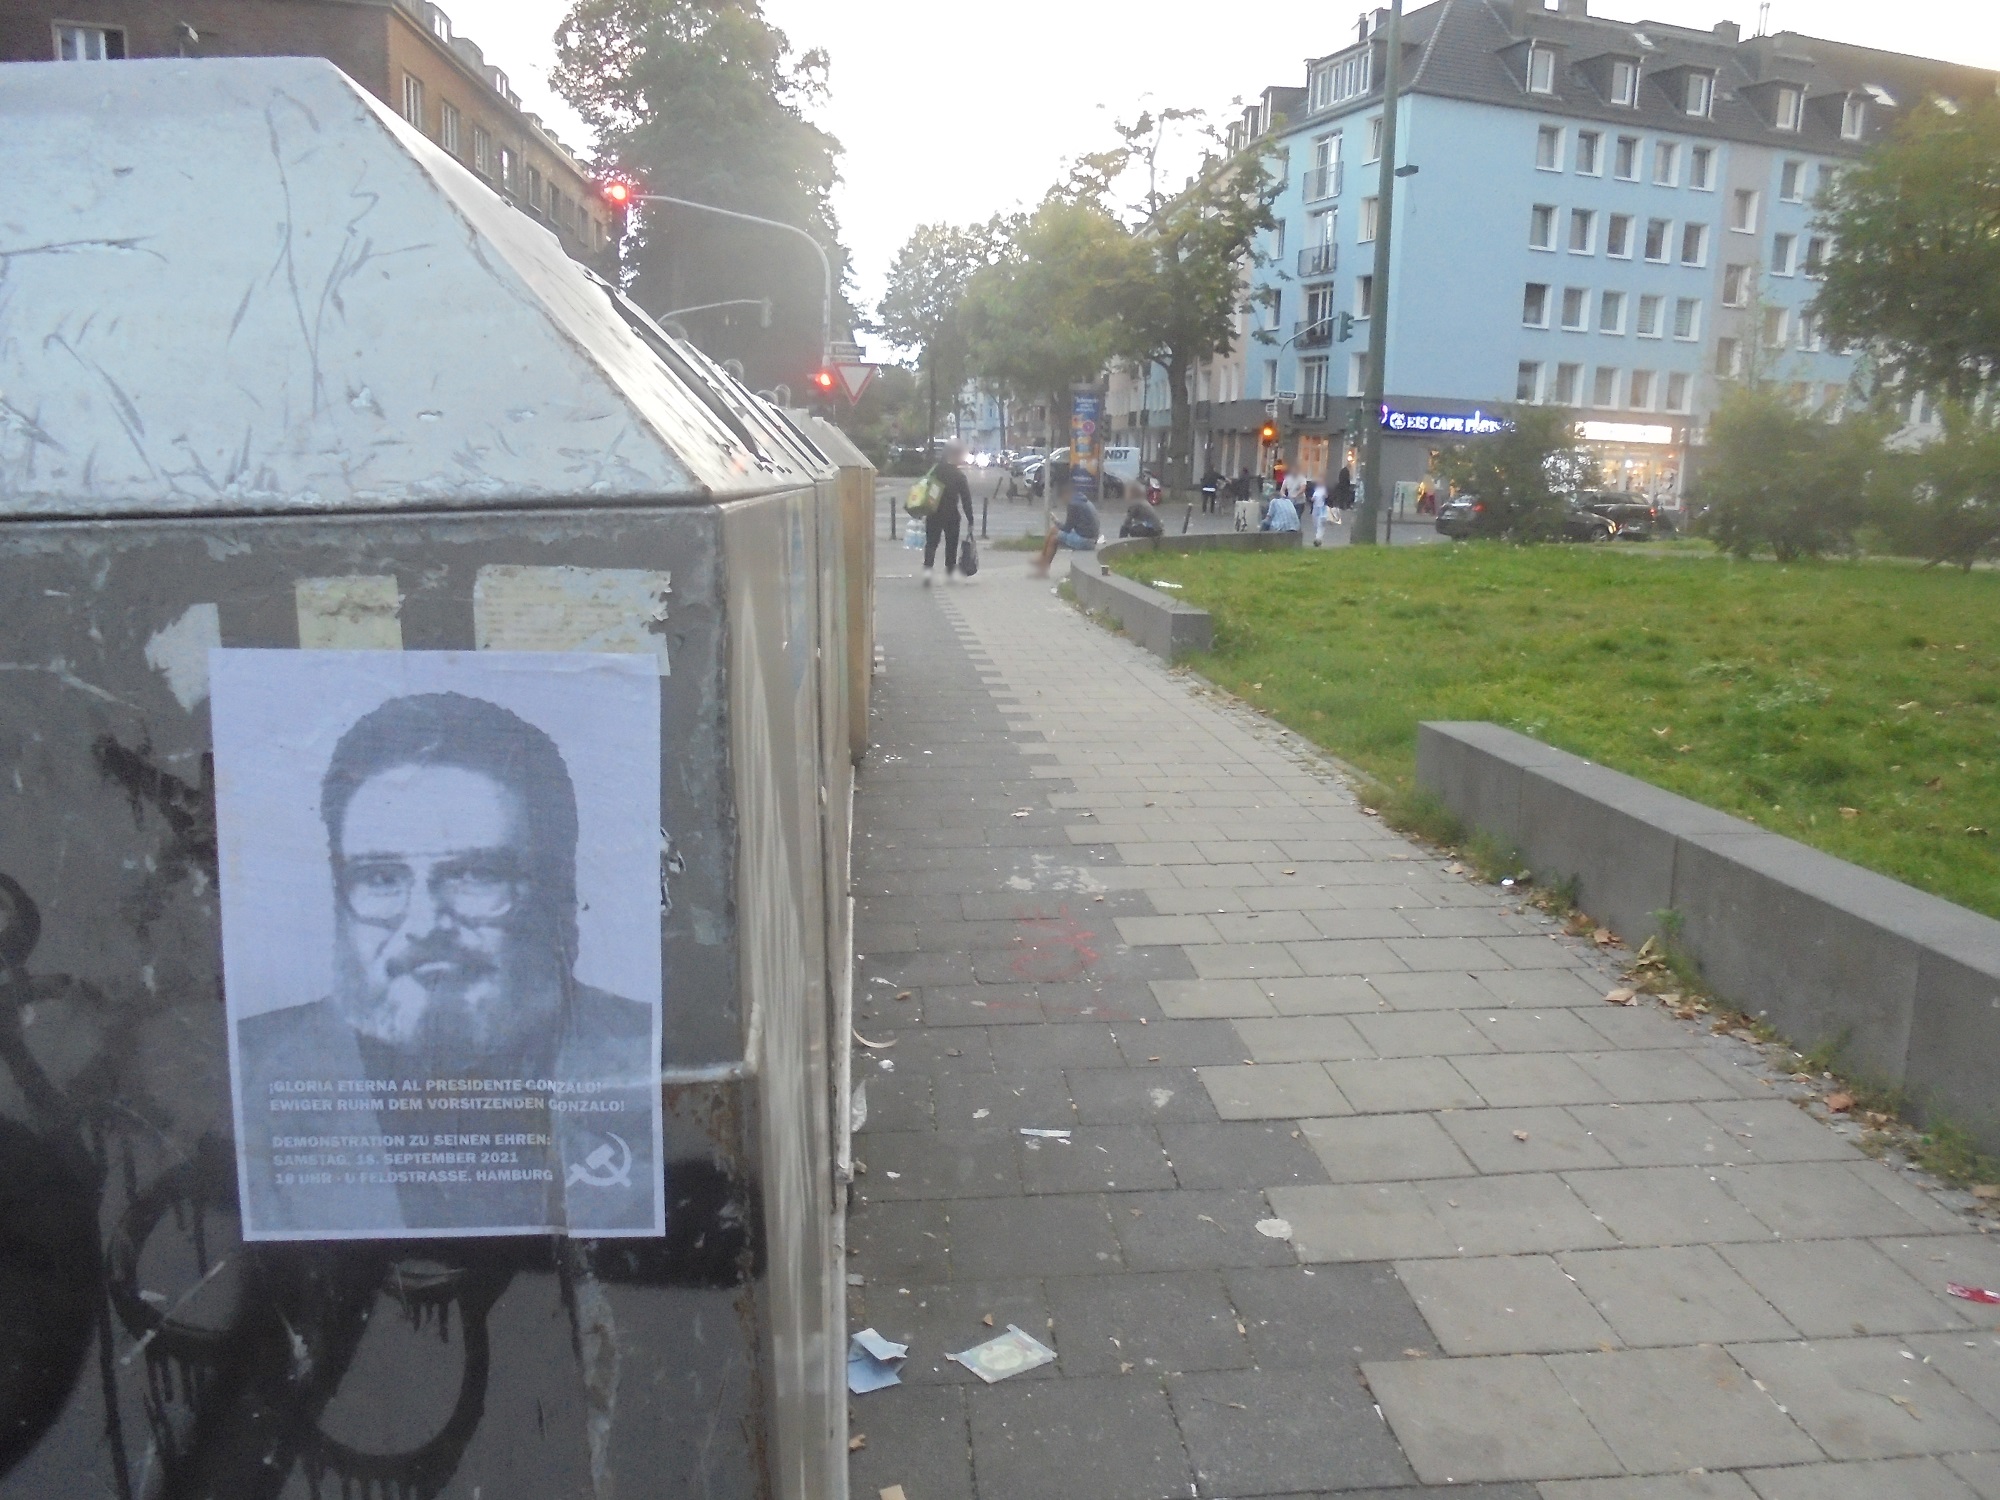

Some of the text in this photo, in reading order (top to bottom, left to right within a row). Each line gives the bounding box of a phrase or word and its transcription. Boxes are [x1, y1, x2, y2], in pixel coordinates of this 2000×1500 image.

[1407, 416, 1428, 429] EIS
[337, 1079, 398, 1092] ETERNA
[401, 1079, 422, 1091] AL
[425, 1078, 523, 1092] PRESIDENTE
[524, 1079, 603, 1094] GONZALO!
[269, 1098, 626, 1112] EWIGER RUHM DEM VORSITZENDEN GONZALO!
[271, 1132, 552, 1148] DEMONSTRATION ZU SEINEN EHREN:
[382, 1152, 477, 1165] SEPTEMBER
[480, 1151, 520, 1164] 2021
[297, 1172, 332, 1185] UHR
[475, 1169, 554, 1182] HAMBURG
